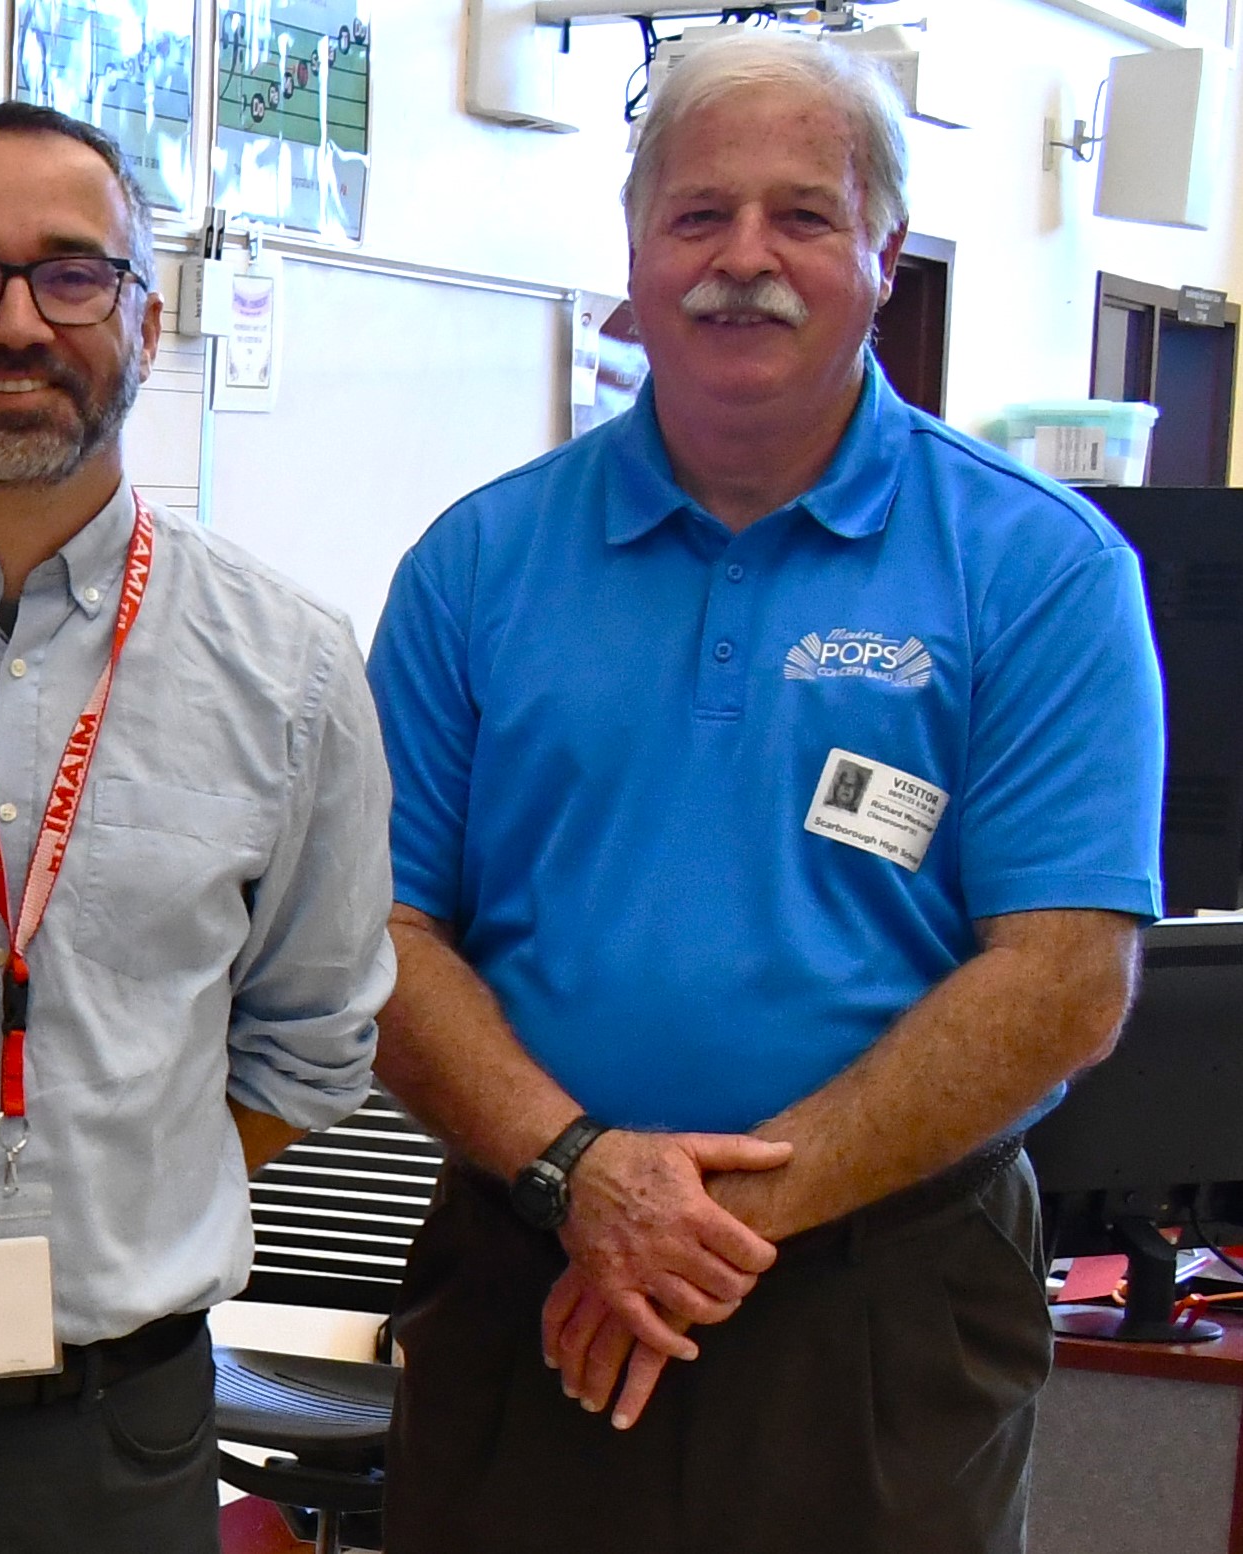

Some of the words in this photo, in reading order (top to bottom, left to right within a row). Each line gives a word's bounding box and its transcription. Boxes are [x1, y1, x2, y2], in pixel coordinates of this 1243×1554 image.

[125, 506, 154, 605] MIAMI
[825, 627, 894, 643] Maine
[819, 641, 900, 669] POPS
[893, 777, 940, 806] VISITOR
[870, 799, 903, 818] Richard
[813, 816, 877, 845] Scarborough
[878, 839, 900, 854] High
